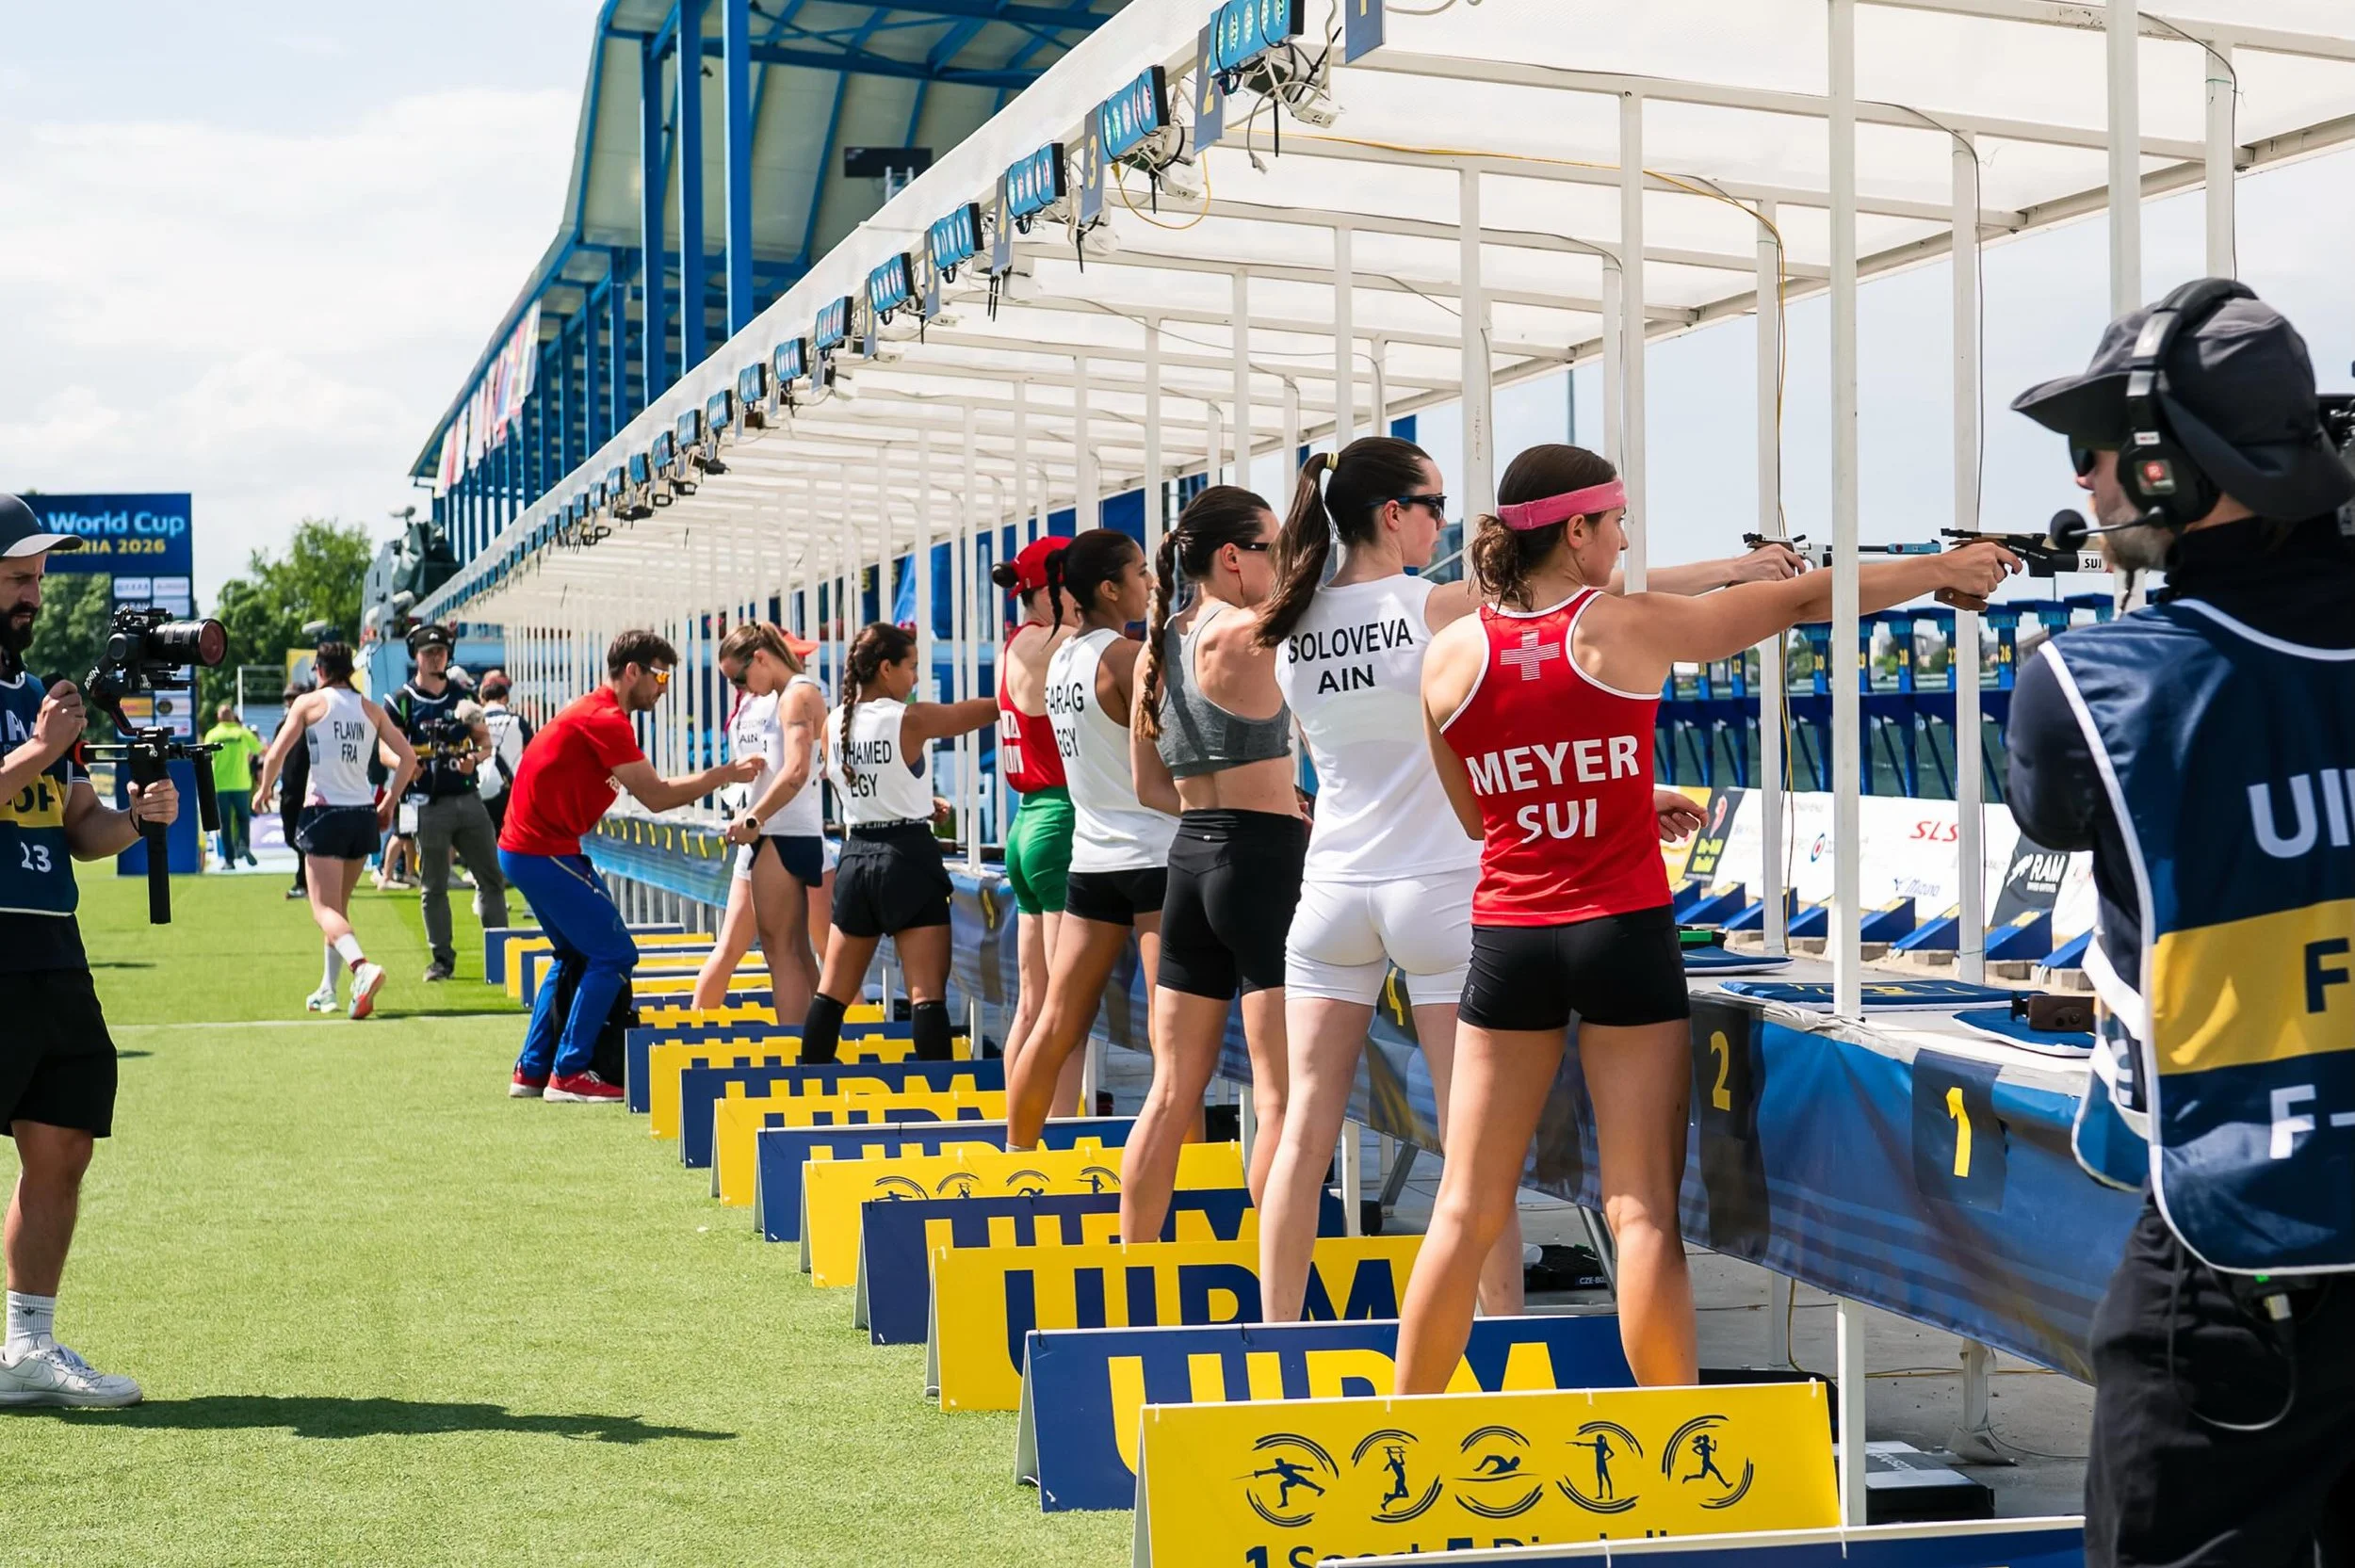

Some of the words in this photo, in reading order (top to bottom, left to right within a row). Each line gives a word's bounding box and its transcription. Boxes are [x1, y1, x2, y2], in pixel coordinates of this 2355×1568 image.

[1088, 134, 1097, 190] 3
[48, 511, 128, 535] World
[135, 511, 185, 538] Cup
[118, 538, 166, 554] 2026
[2085, 558, 2102, 569] SUI
[1288, 618, 1413, 664] SOLOVEVA
[1317, 664, 1375, 695] AIN
[333, 720, 365, 742] FLAVIN
[342, 743, 357, 764] FRA
[833, 739, 892, 765] MHAMED
[1465, 736, 1640, 797] MEYER
[1516, 799, 1598, 845] SUI
[2248, 768, 2355, 858] UI
[2029, 853, 2067, 883] RAM
[1710, 1030, 1731, 1112] 2
[1945, 1086, 1973, 1178] 1
